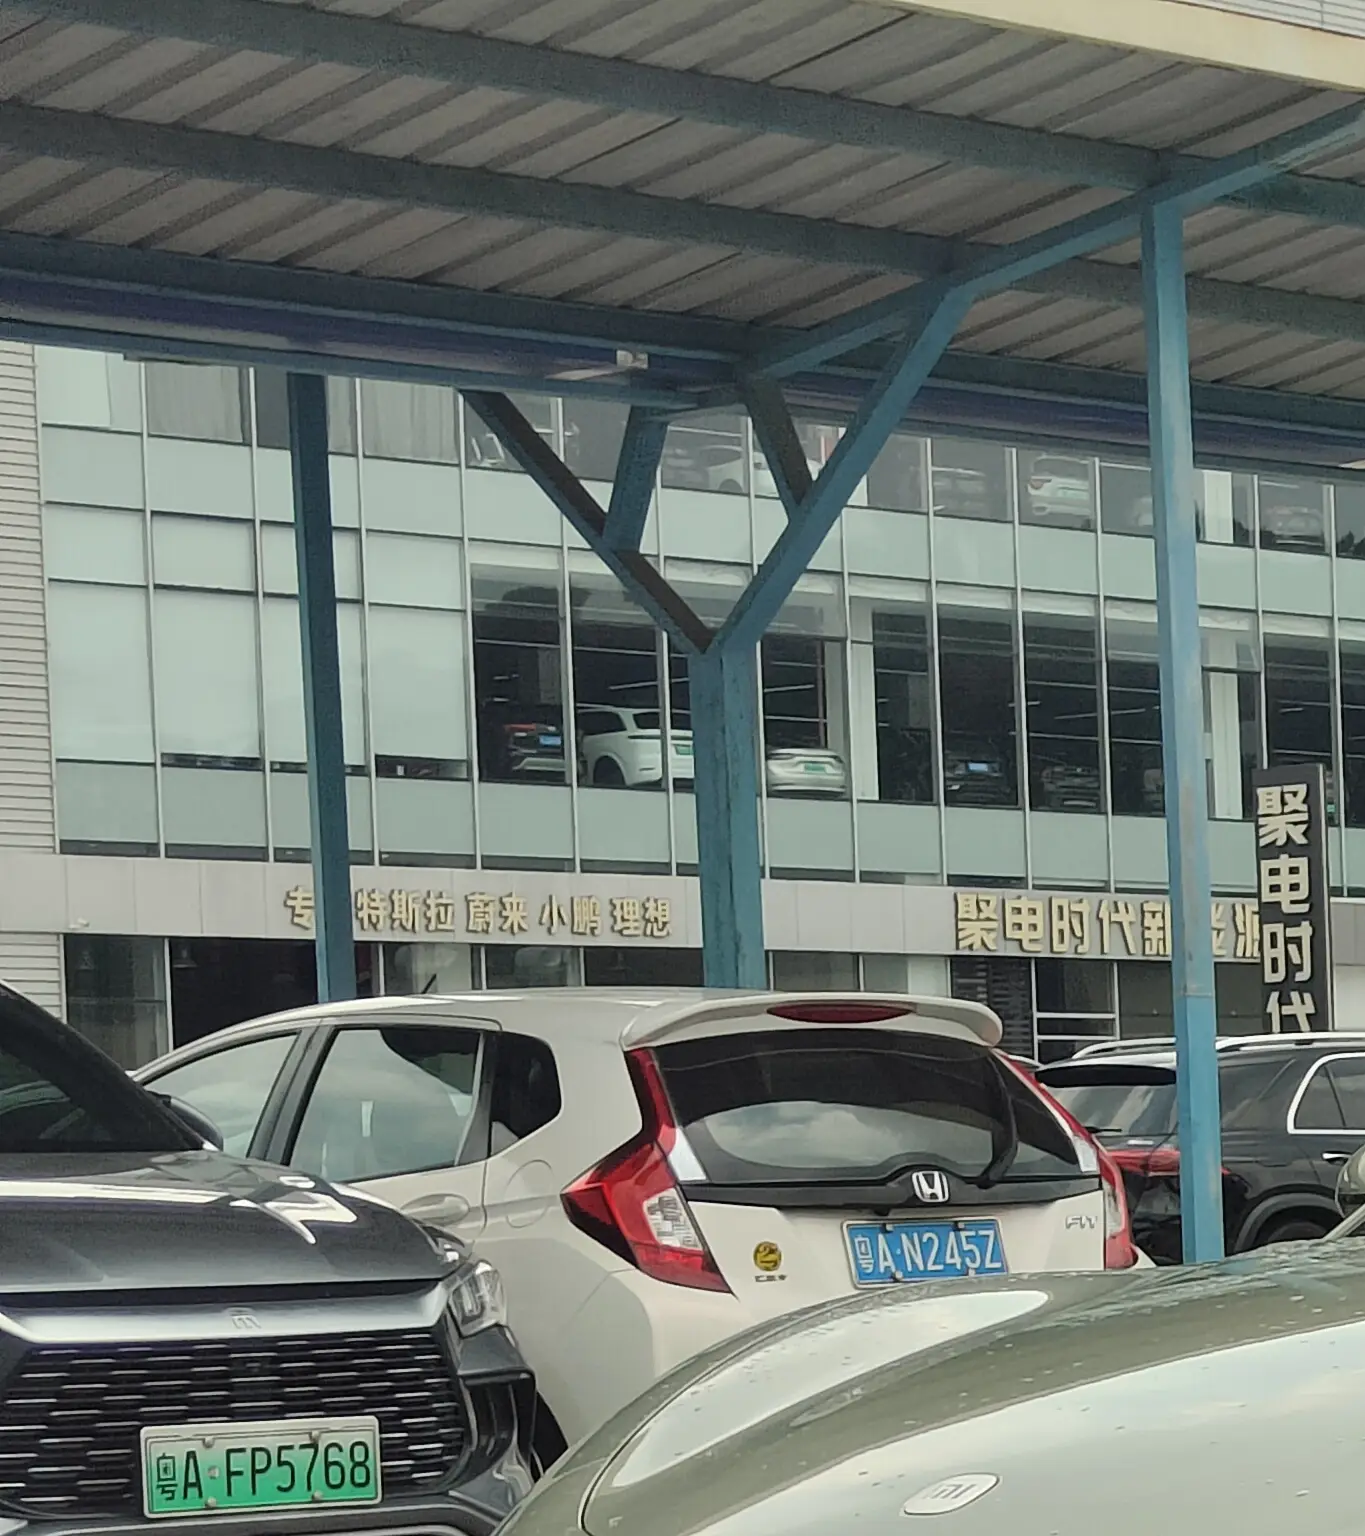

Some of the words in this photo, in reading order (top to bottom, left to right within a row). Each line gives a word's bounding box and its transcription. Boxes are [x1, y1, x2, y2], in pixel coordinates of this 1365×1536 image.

[284, 886, 456, 934] 专特斯拉
[610, 896, 672, 938] 理想
[1256, 783, 1318, 1033] 聚电时代
[1065, 1215, 1098, 1230] FIT
